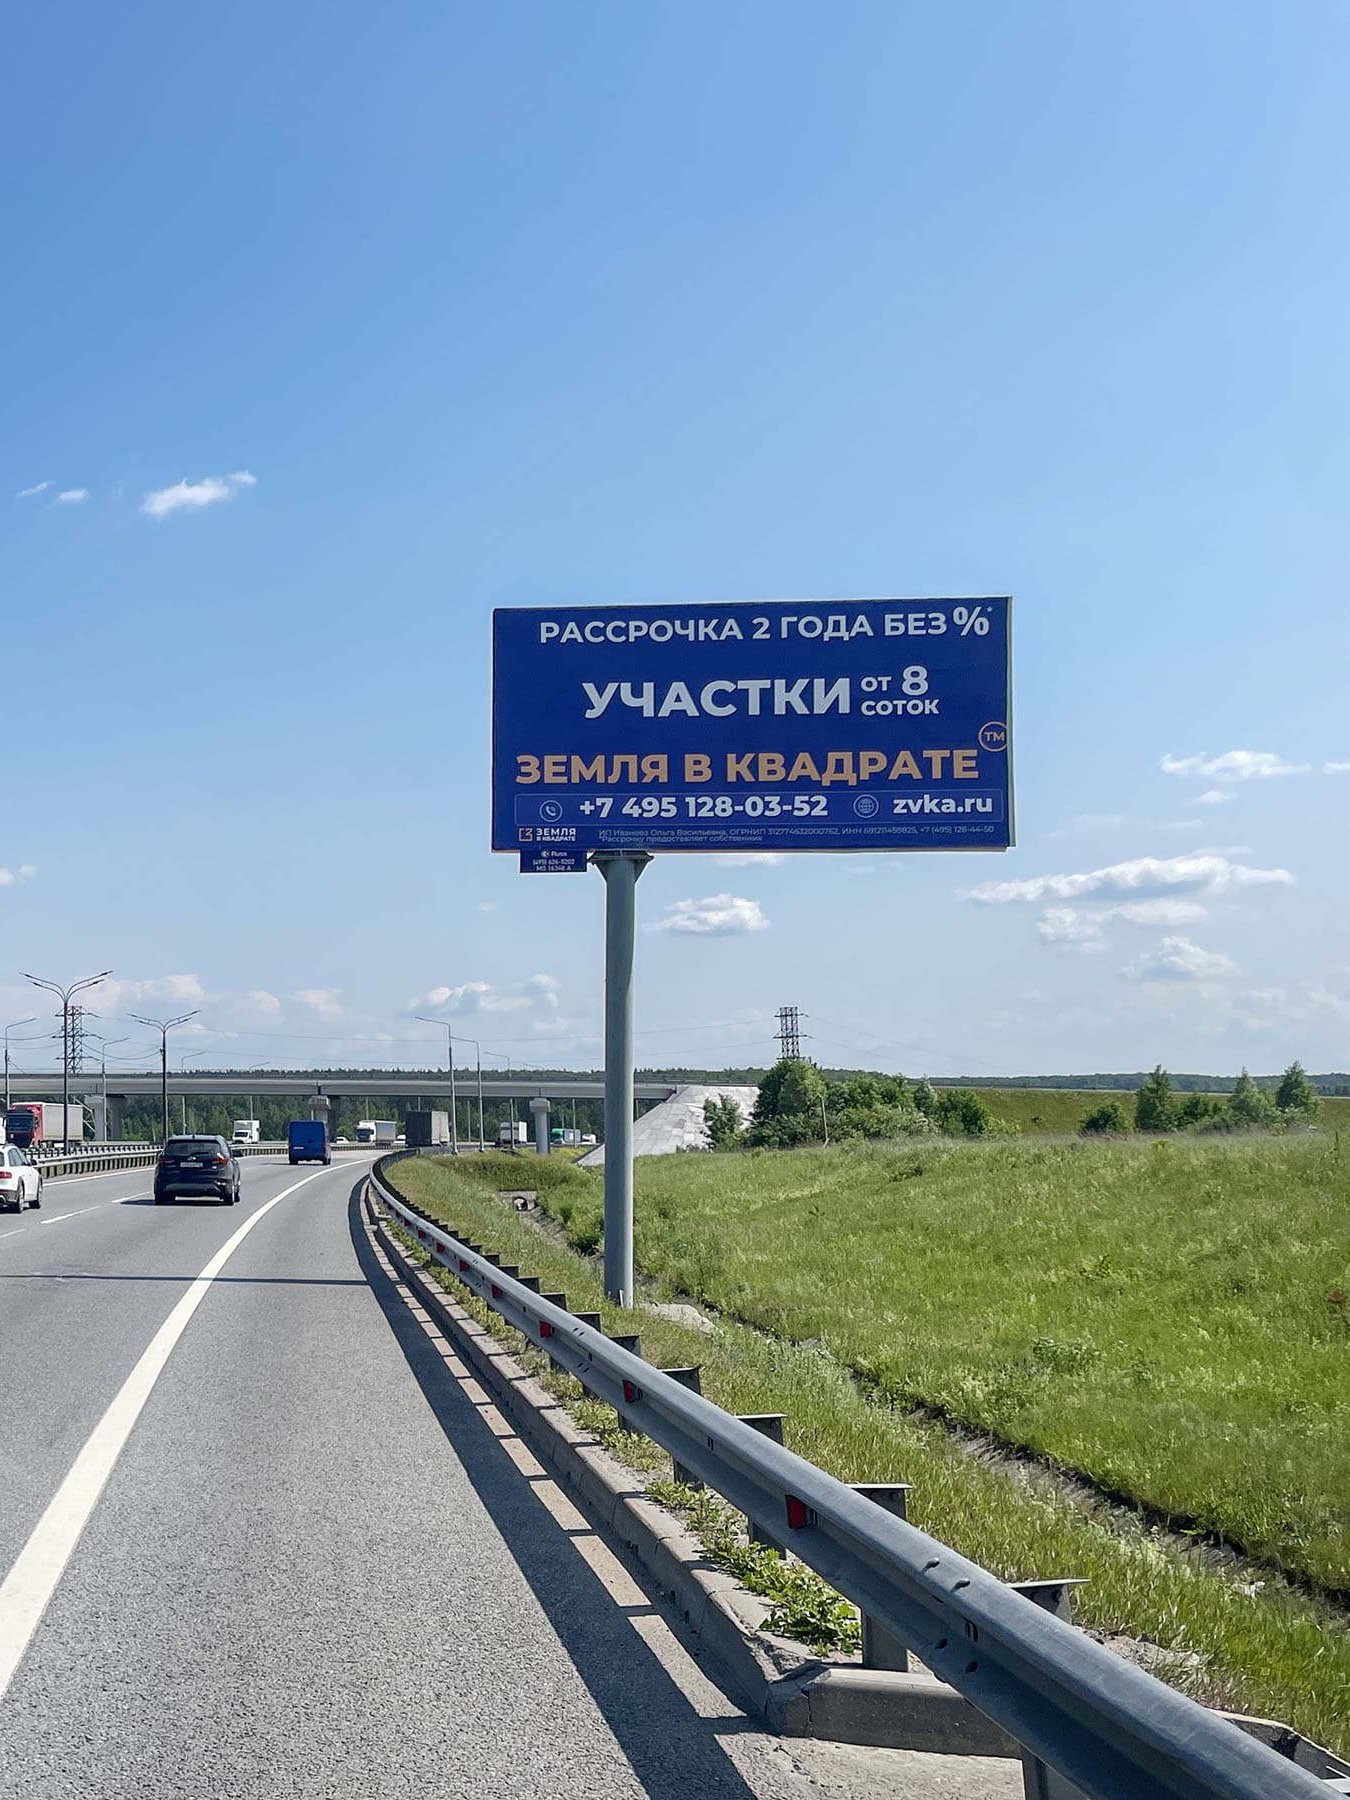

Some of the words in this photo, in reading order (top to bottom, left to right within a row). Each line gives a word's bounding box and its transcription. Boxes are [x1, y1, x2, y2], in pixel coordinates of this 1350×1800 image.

[540, 618, 744, 643] РАССРОЧКА
[752, 617, 771, 640] 2
[781, 614, 874, 641] ГОДА
[884, 612, 947, 637] БЕЗ
[901, 665, 929, 696] 8
[582, 678, 850, 719] УЧАСТКИ
[515, 754, 668, 784] ЗЕМЛЯ
[684, 753, 712, 783] В
[726, 749, 979, 787] КВАДРАТЕ
[580, 797, 613, 818] +7
[621, 796, 677, 818] 495
[685, 795, 828, 818] 128-03-52
[893, 794, 993, 815] zvka.ru
[536, 828, 576, 836] ЗЕМЛЯ
